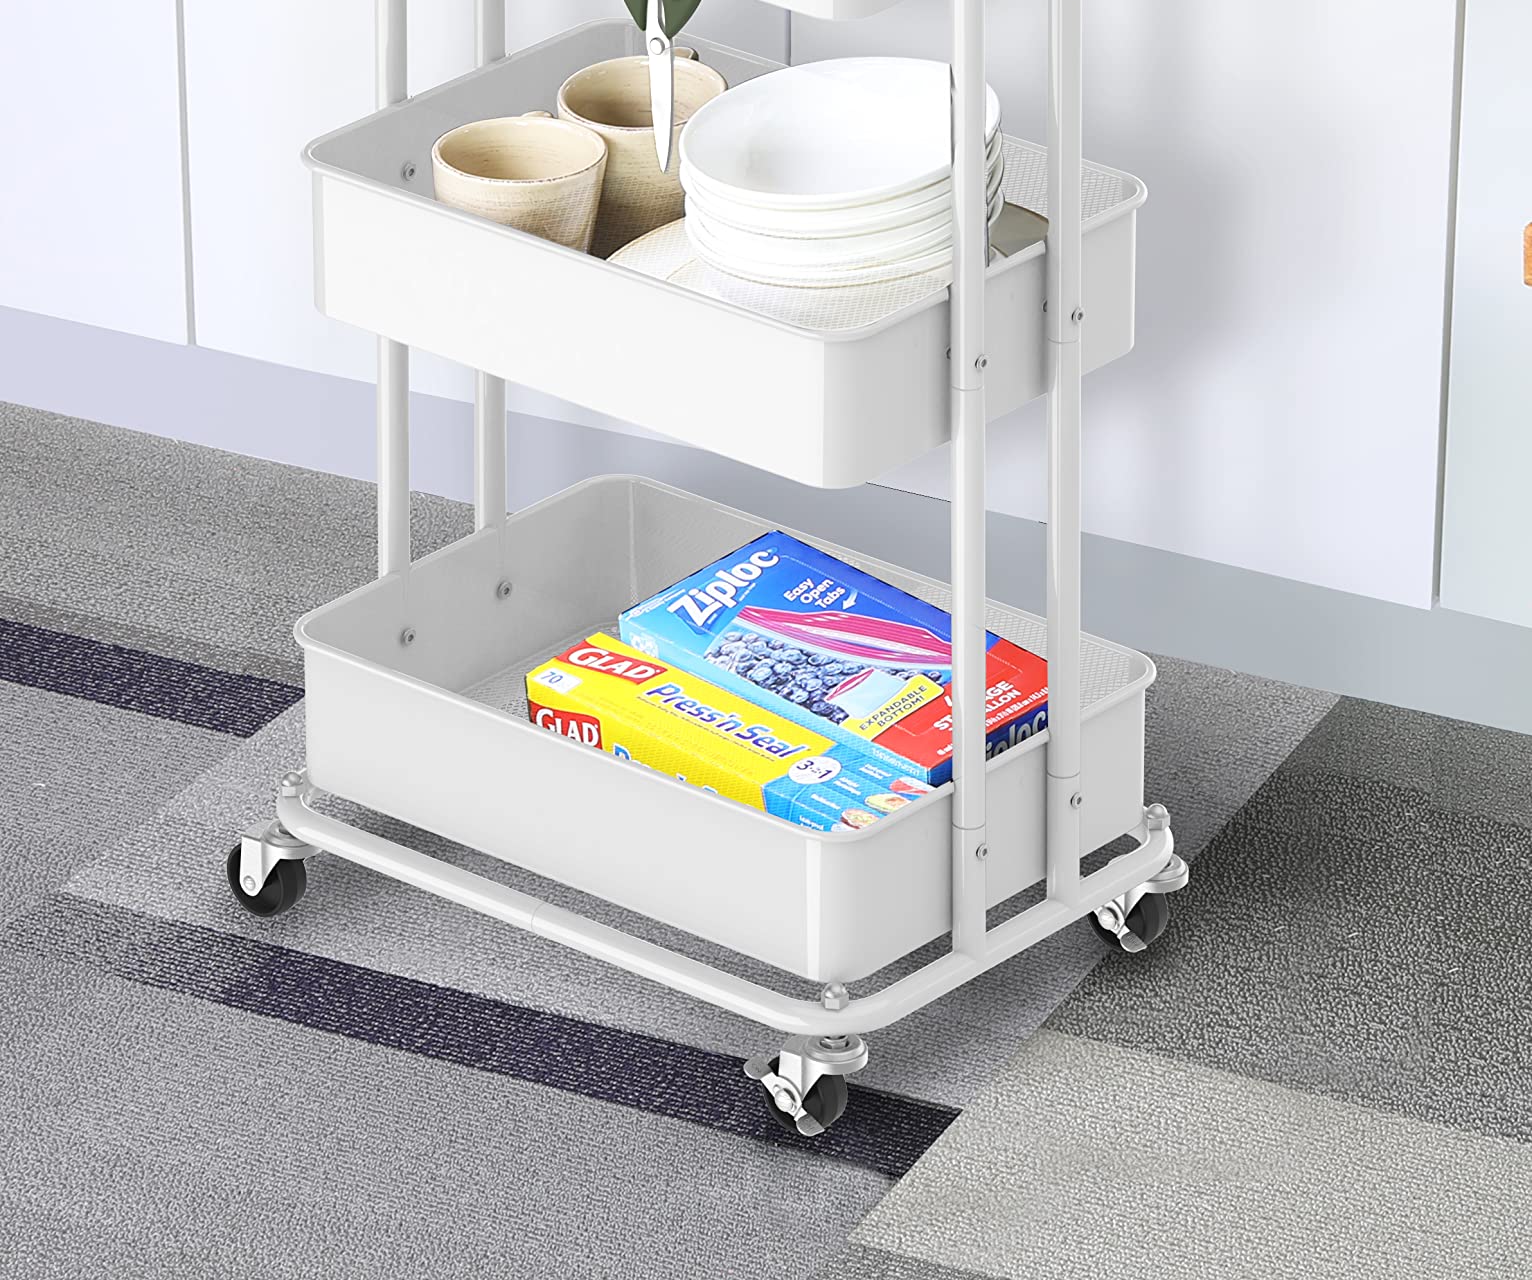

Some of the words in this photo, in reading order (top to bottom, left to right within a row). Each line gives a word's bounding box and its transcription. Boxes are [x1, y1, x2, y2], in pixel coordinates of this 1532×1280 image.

[667, 551, 780, 627] Ziploc
[783, 578, 815, 602] Easy
[799, 579, 834, 604] Open
[814, 586, 846, 609] Tabs
[540, 671, 564, 685] 70
[568, 648, 658, 679] GLAD
[859, 685, 927, 731] EXPANDABLE
[877, 695, 925, 727] BOTTOM!
[535, 708, 600, 746] GLAD
[734, 724, 806, 758] Seal
